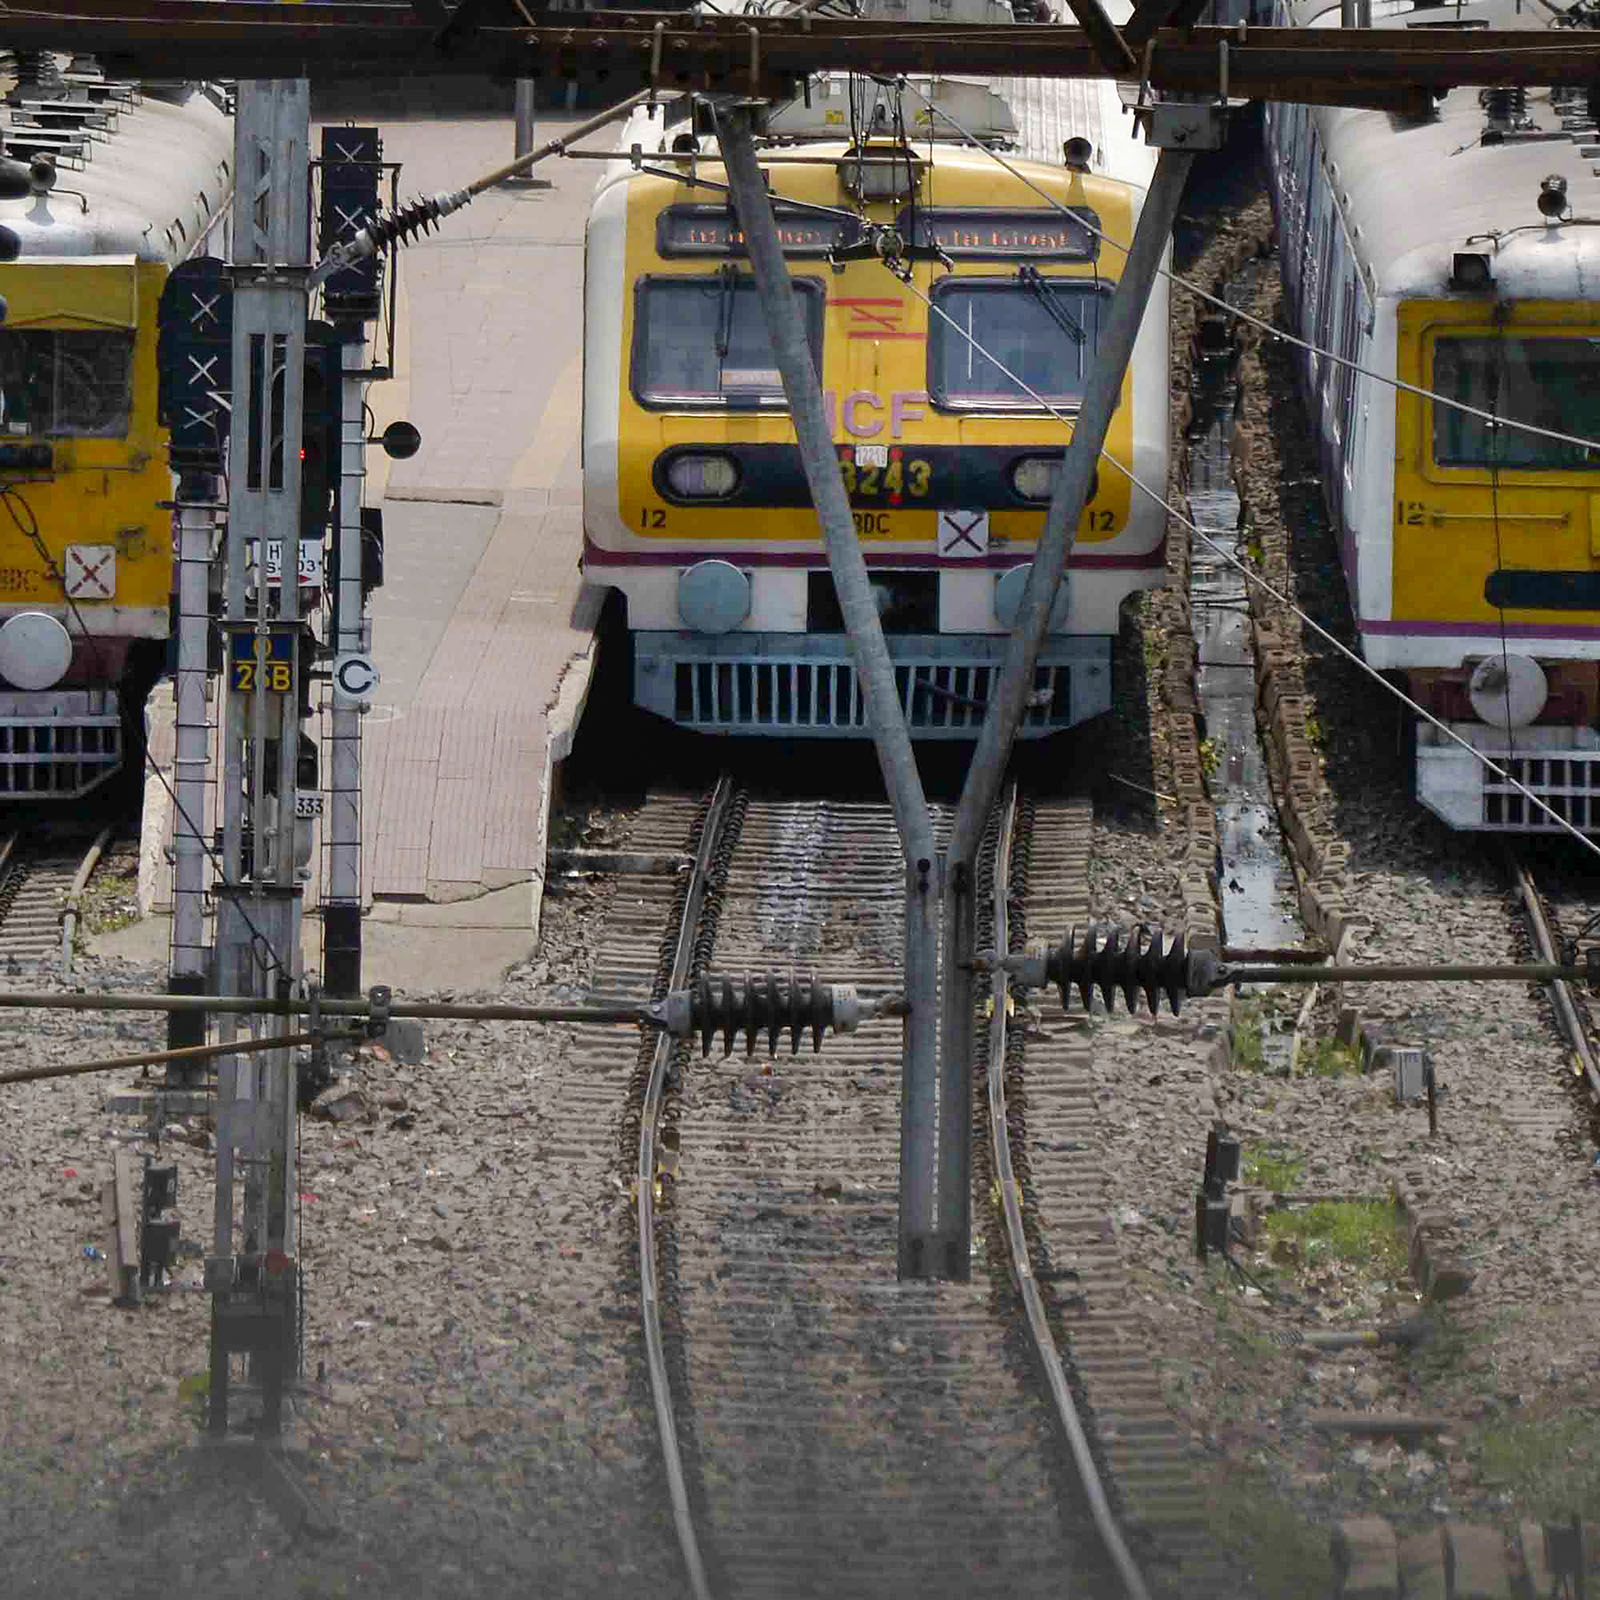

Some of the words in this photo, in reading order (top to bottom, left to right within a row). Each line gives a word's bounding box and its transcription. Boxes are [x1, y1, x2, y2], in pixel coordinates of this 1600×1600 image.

[825, 390, 930, 439] ICF
[639, 509, 667, 529] 12
[1088, 511, 1115, 532] 12
